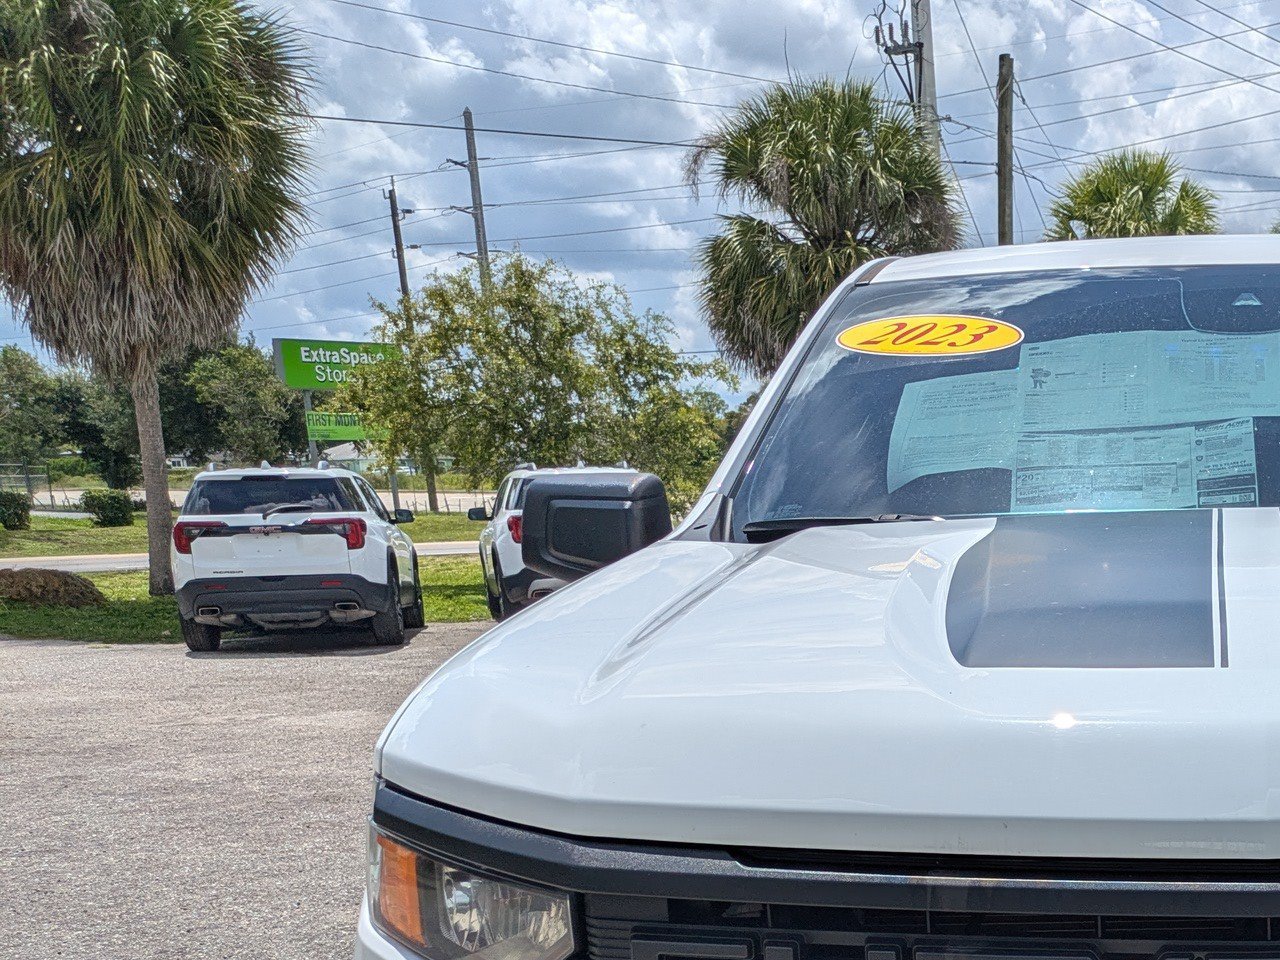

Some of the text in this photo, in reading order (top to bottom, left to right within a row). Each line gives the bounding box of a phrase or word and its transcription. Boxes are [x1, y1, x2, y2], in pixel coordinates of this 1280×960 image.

[857, 323, 998, 348] 2023
[300, 347, 385, 367] ExtraSpace
[306, 413, 332, 427] FIRST
[249, 524, 282, 534] GMC
